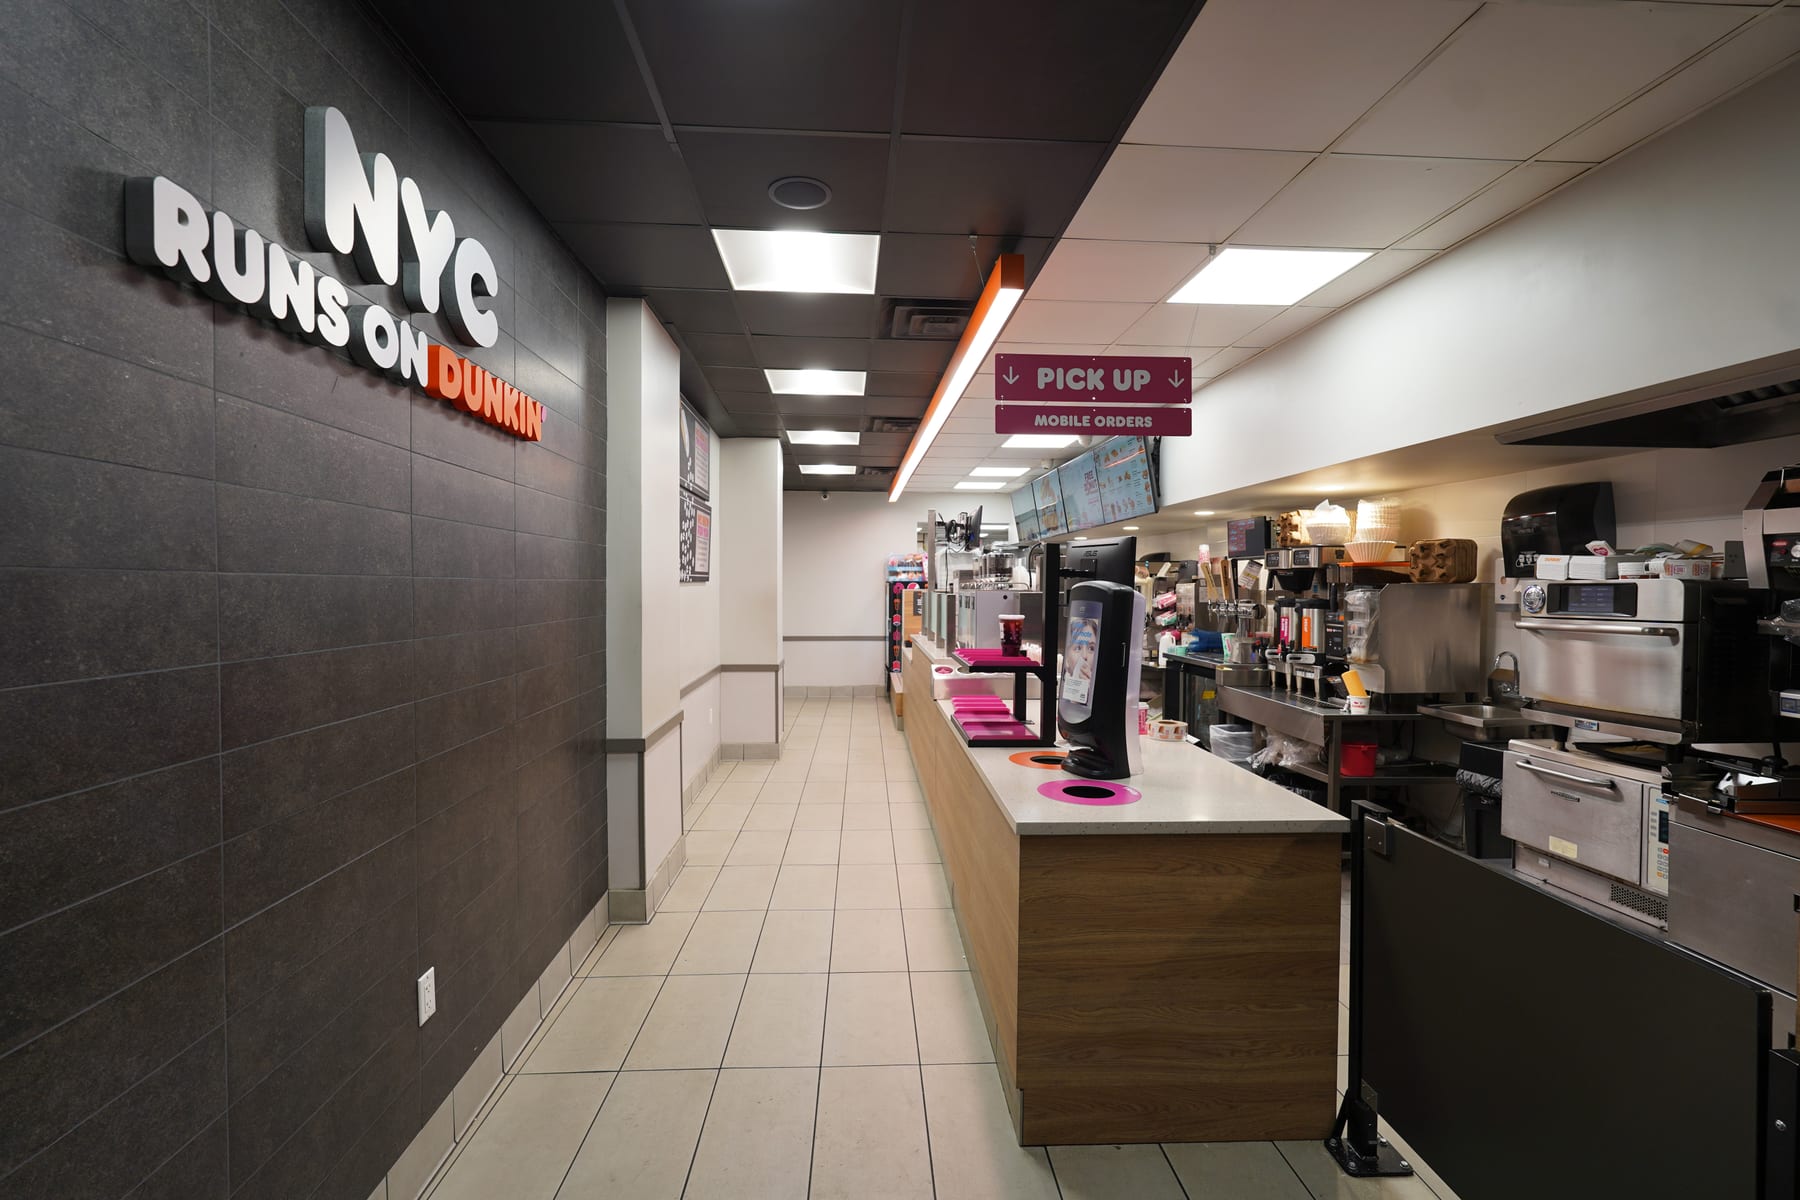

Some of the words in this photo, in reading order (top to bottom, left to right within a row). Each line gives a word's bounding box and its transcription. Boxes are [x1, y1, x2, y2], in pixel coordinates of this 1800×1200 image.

[150, 175, 350, 348] RUNS
[361, 304, 429, 388] ON
[322, 106, 499, 349] NYC
[1034, 414, 1091, 427] MOBILE
[1094, 415, 1153, 428] ORDERS
[1037, 367, 1105, 392] PICK
[1112, 368, 1151, 392] UP
